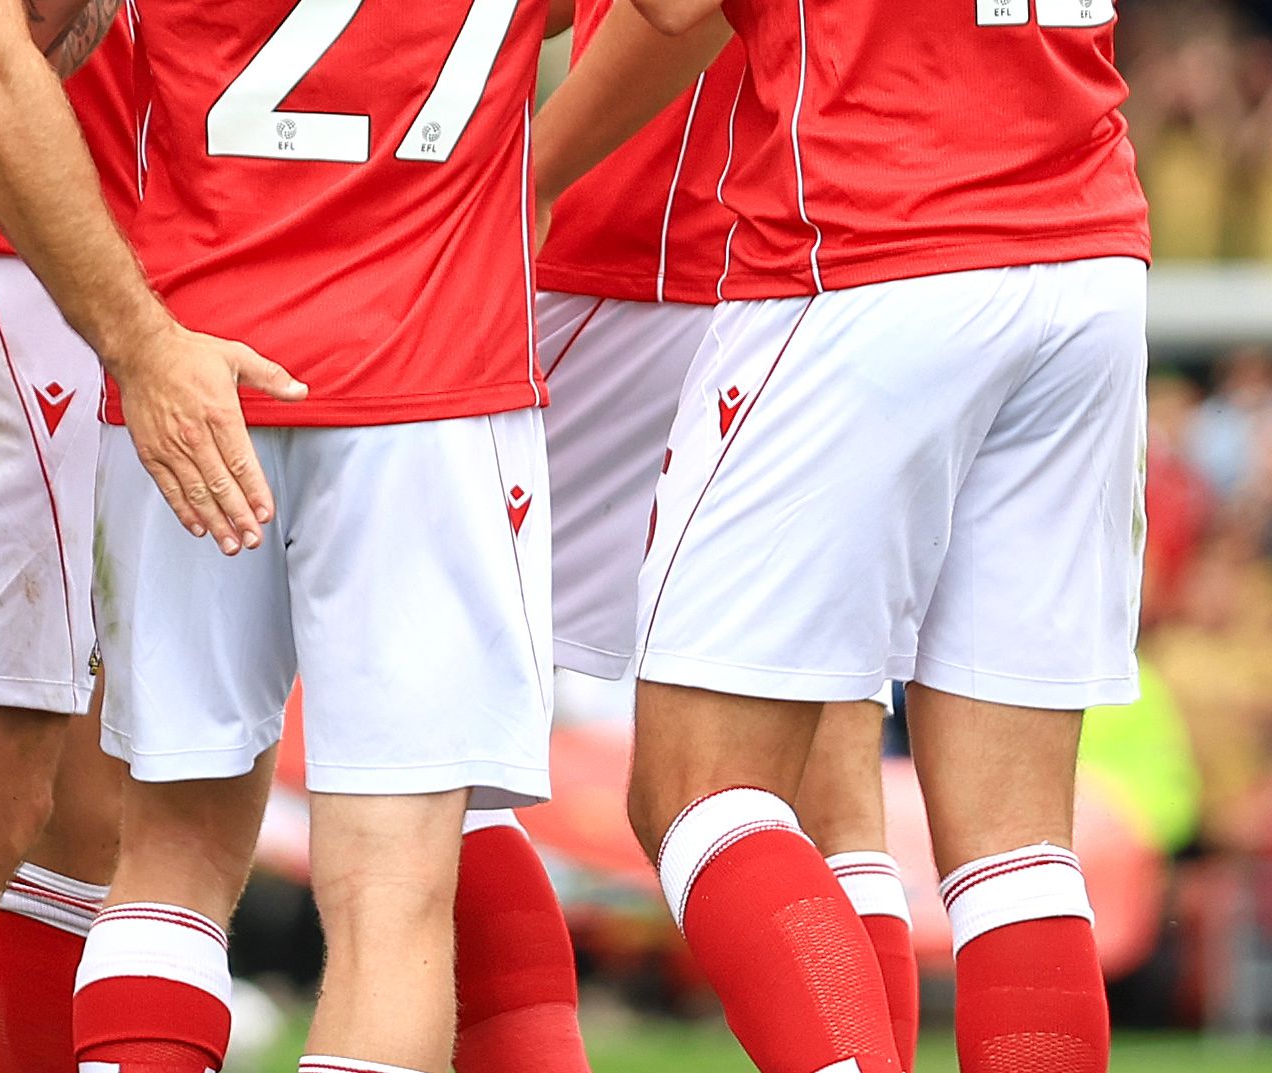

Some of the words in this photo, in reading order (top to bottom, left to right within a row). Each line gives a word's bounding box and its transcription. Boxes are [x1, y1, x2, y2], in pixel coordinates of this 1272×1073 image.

[993, 8, 1012, 17] EFL
[1080, 9, 1093, 19] EFL
[278, 141, 295, 151] EFL
[420, 143, 437, 153] EFL
